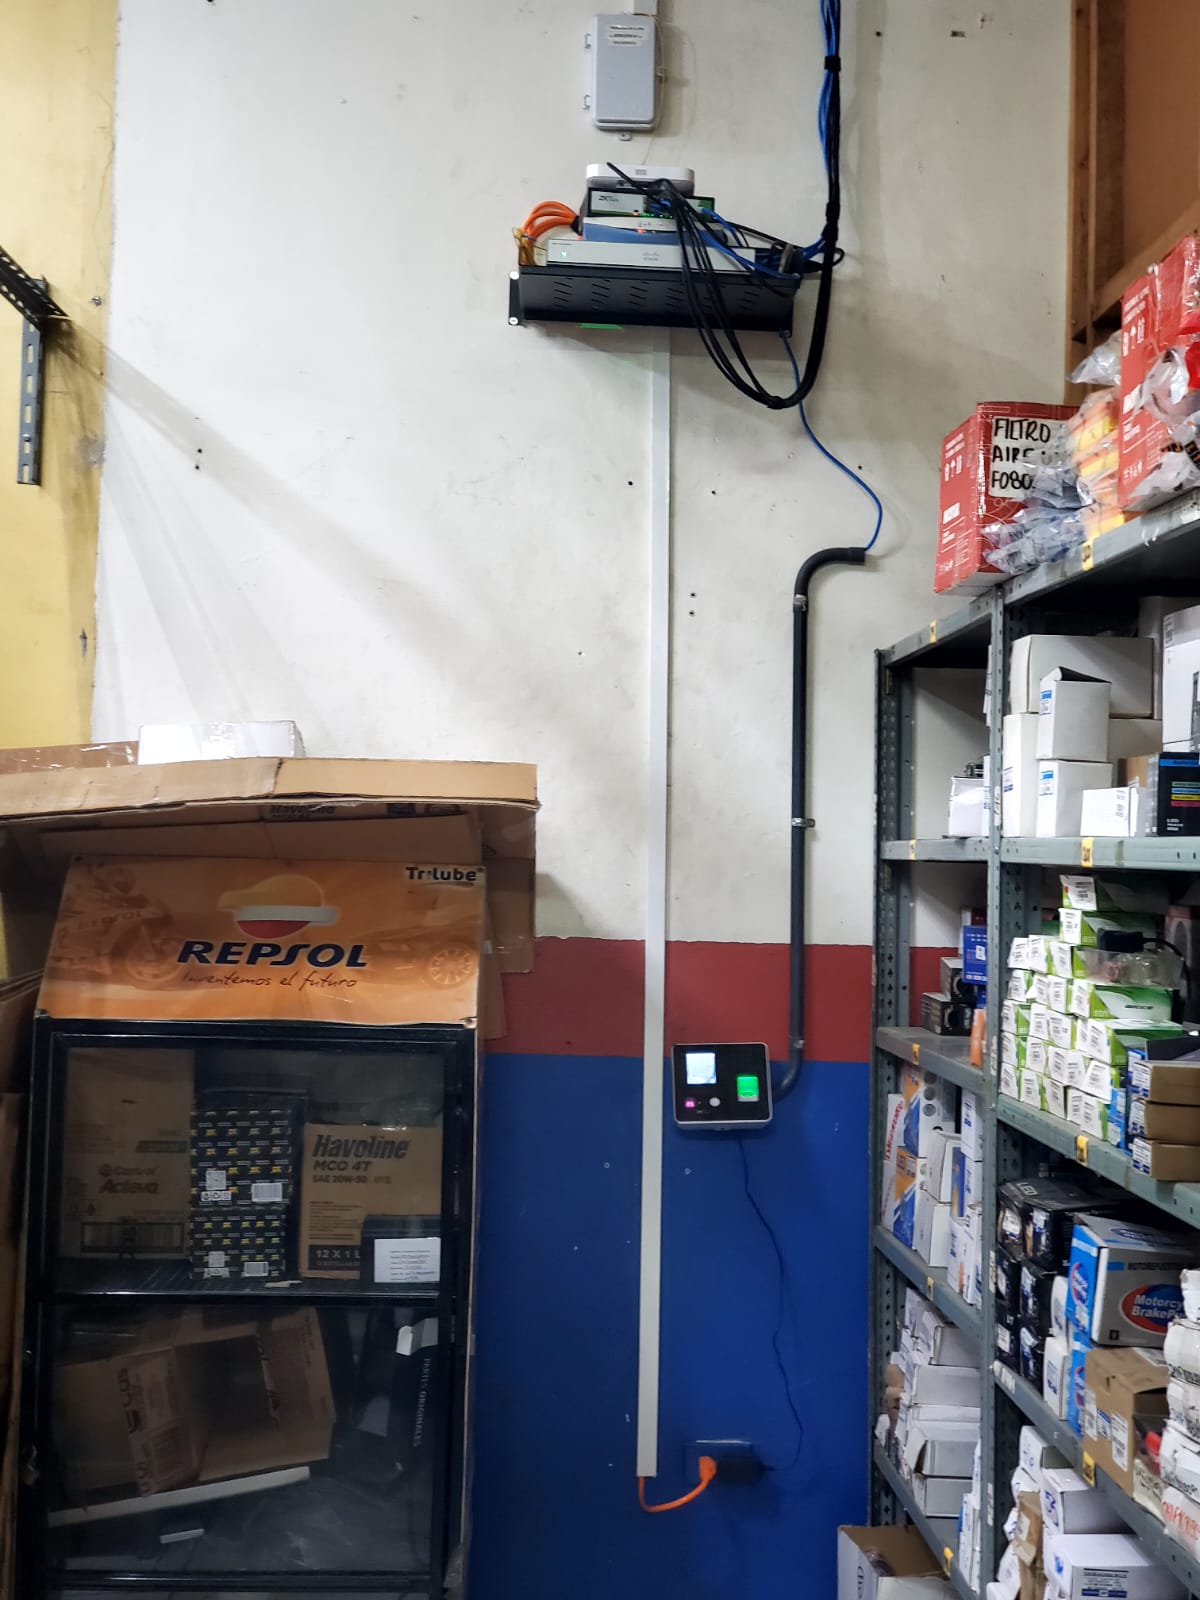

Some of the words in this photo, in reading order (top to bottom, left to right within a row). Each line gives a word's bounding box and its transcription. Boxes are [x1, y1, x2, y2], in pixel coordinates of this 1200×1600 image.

[994, 418, 1051, 443] FILTRO
[176, 940, 368, 968] REPSOL
[279, 971, 298, 987] el
[298, 970, 357, 991] futuro
[312, 1134, 412, 1159] Havoline
[313, 1160, 349, 1171] MCO
[352, 1160, 374, 1172] 4T
[315, 1249, 330, 1259] 12
